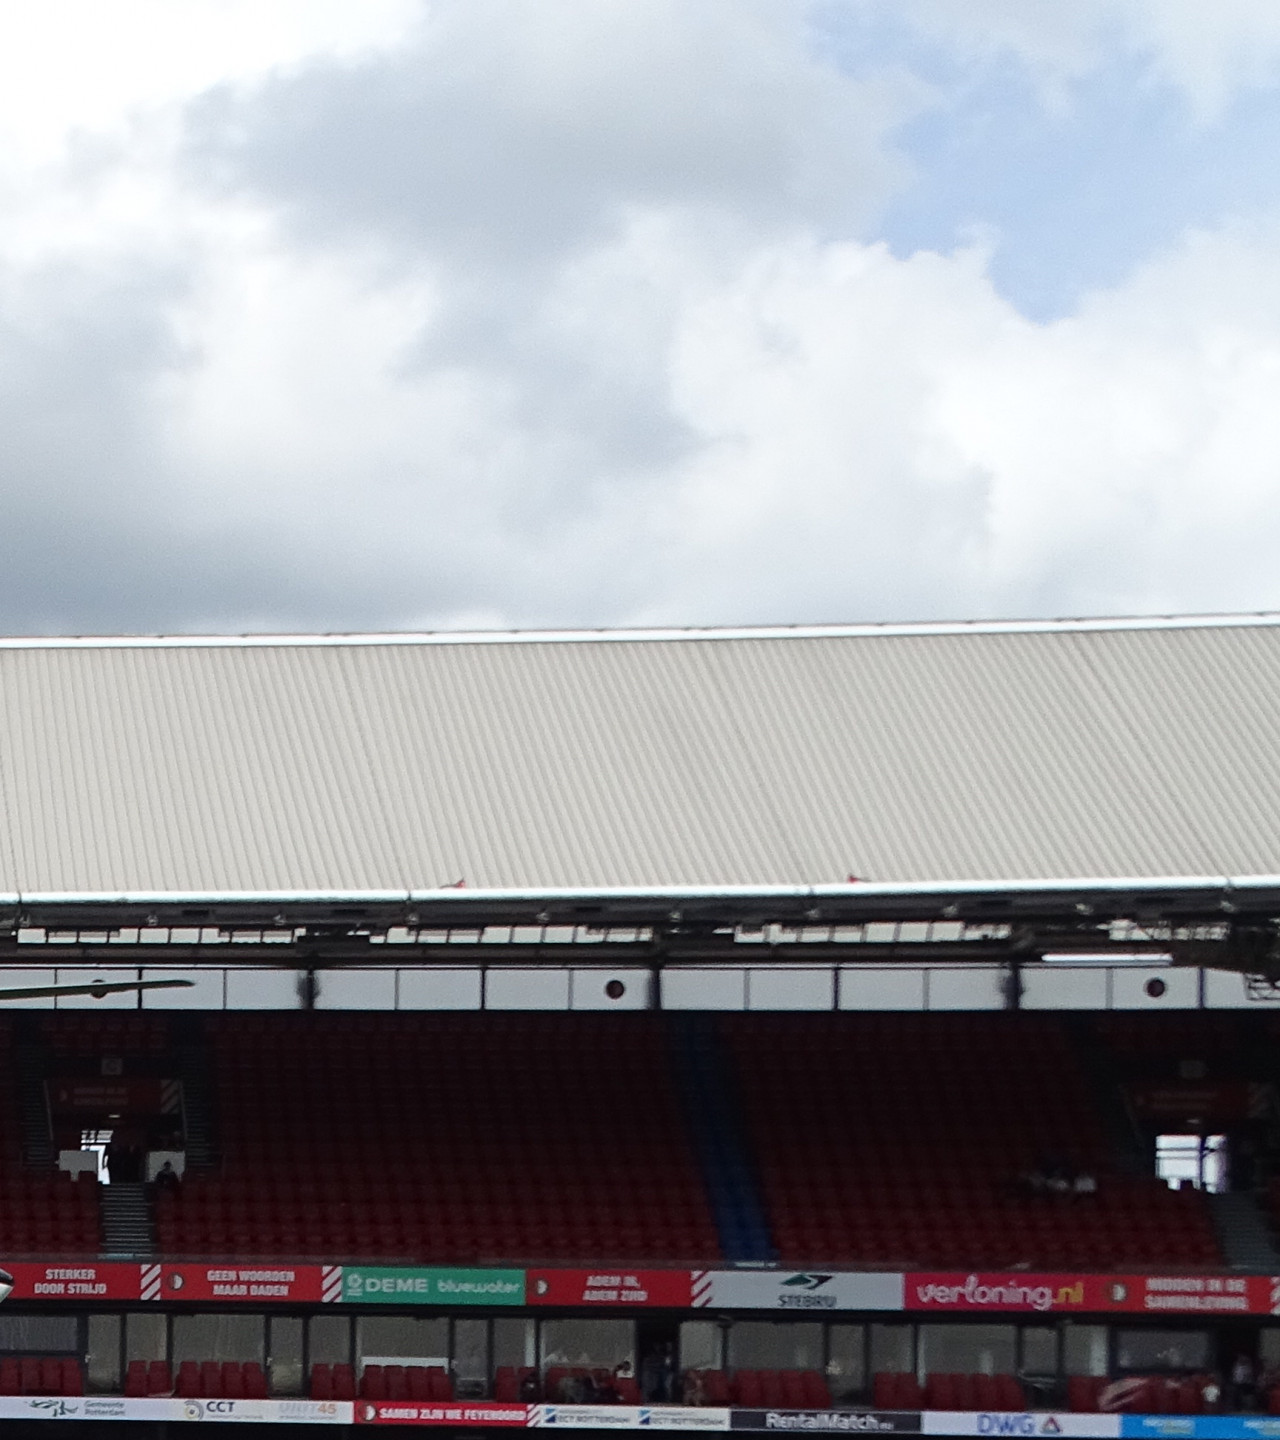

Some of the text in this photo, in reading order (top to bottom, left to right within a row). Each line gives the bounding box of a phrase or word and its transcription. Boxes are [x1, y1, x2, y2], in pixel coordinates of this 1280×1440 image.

[45, 1268, 96, 1281] STERKER
[206, 1270, 295, 1283] GEEN WOORDEN
[34, 1282, 107, 1295] DOOR STRIJD
[213, 1285, 289, 1297] MAAR DADEN
[365, 1278, 429, 1293] DEME
[437, 1280, 521, 1294] bluewater
[917, 1275, 1084, 1311] verloning.nl
[778, 1294, 837, 1308] STEBRU
[206, 1401, 235, 1413] CCT
[977, 1415, 1035, 1434] DWG
